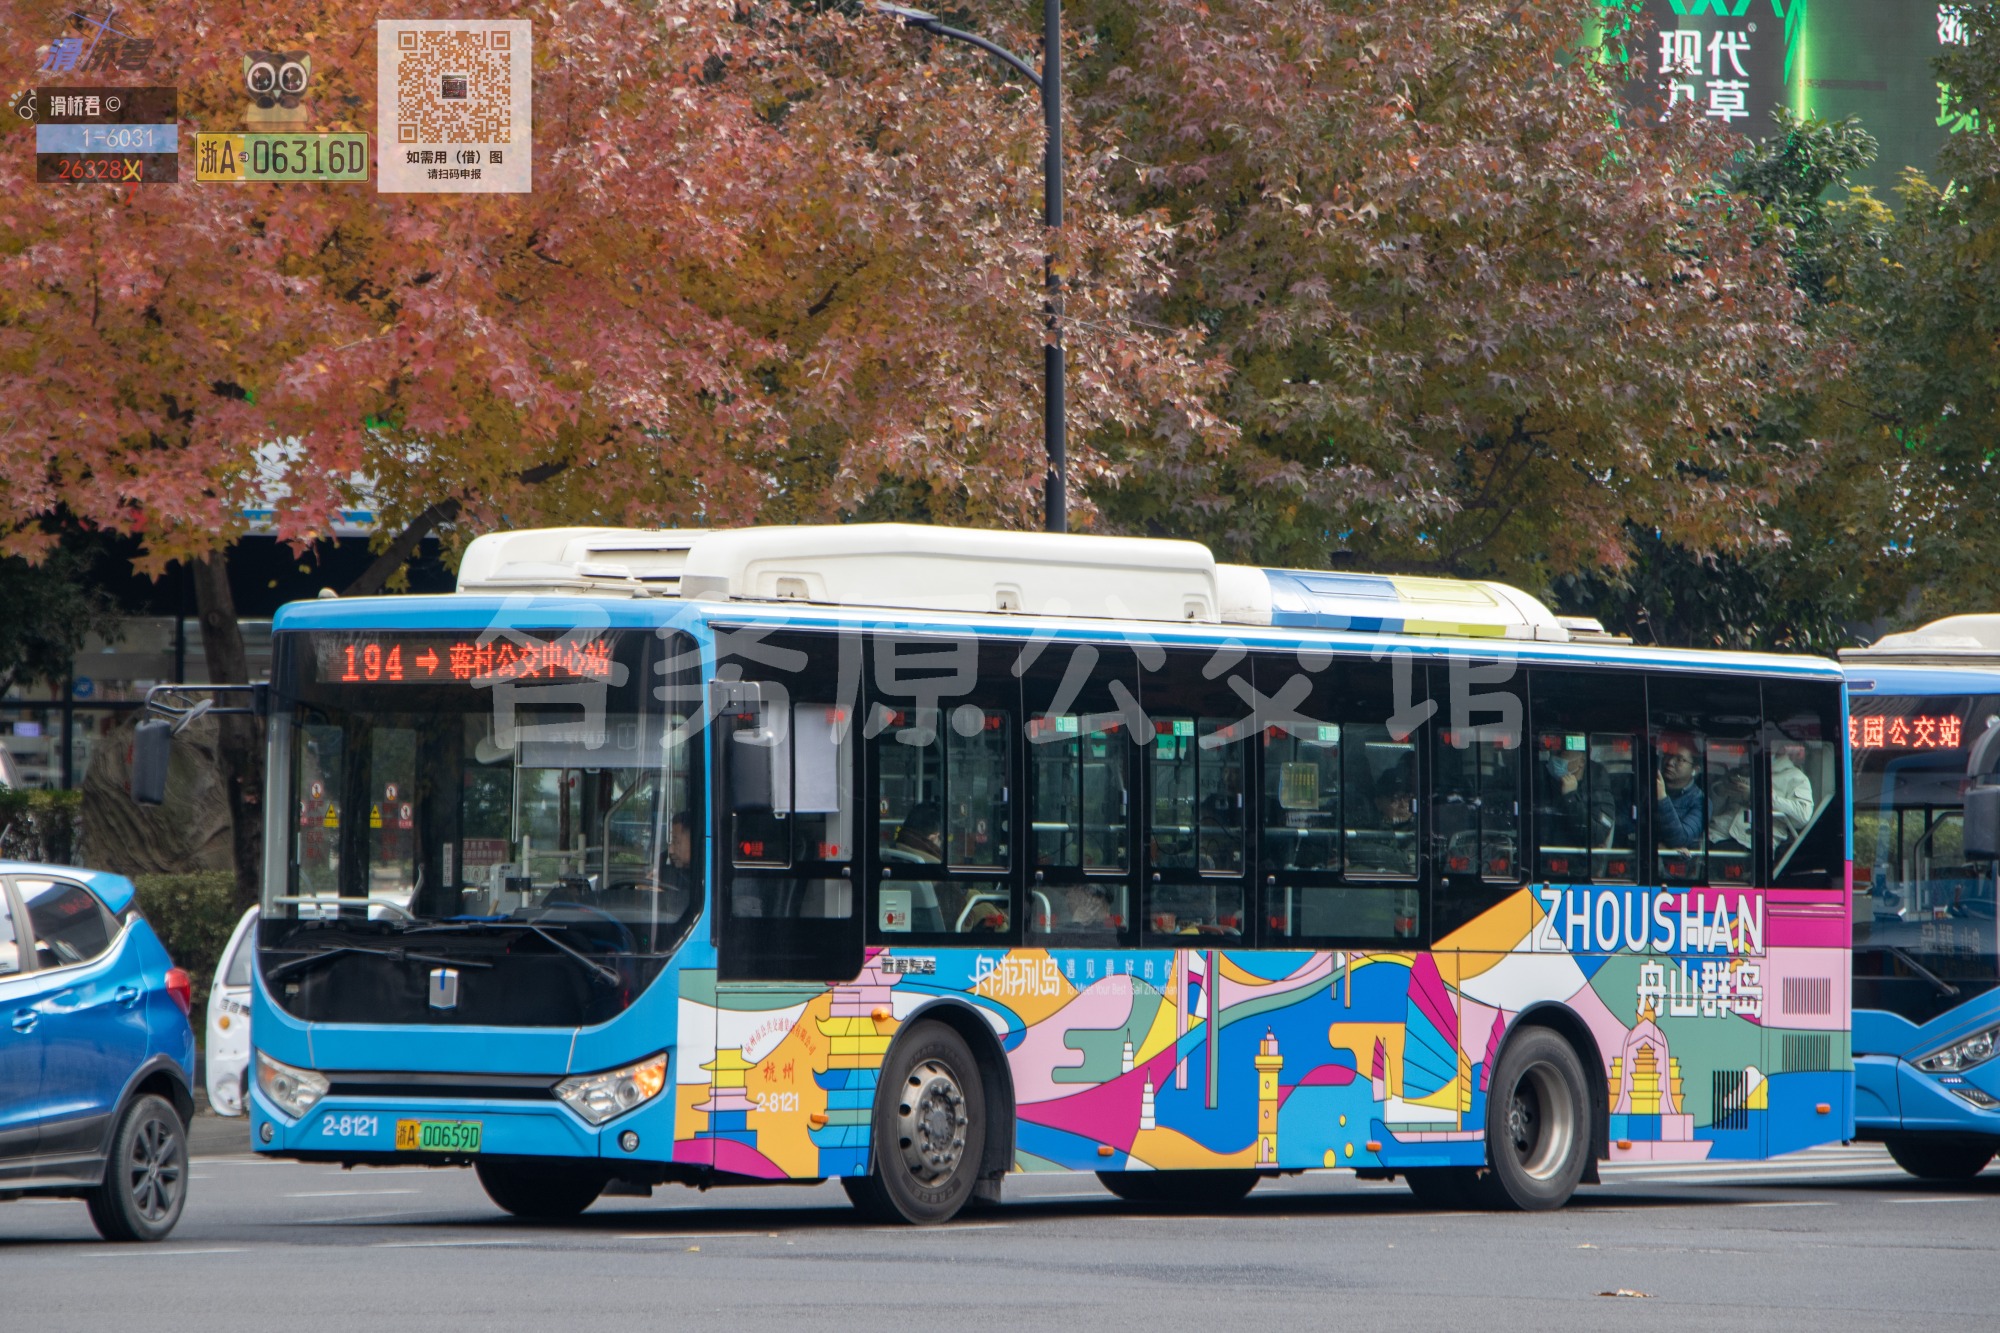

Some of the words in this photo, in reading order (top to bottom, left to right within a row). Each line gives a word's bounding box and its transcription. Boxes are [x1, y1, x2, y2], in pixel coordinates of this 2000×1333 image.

[1658, 29, 1751, 77] 现代
[342, 643, 404, 682] 194
[449, 639, 610, 680] 蒋村公交中心站
[1539, 888, 1763, 956] ZHOUSHAN
[881, 955, 936, 976] 远程汽车
[1096, 983, 1110, 995] Your
[1112, 983, 1126, 995] Best
[1636, 959, 1764, 1019] 舟山群岛
[763, 1058, 795, 1085] 杭州
[756, 1092, 799, 1113] 2-8121
[321, 1115, 379, 1137] 2-8121
